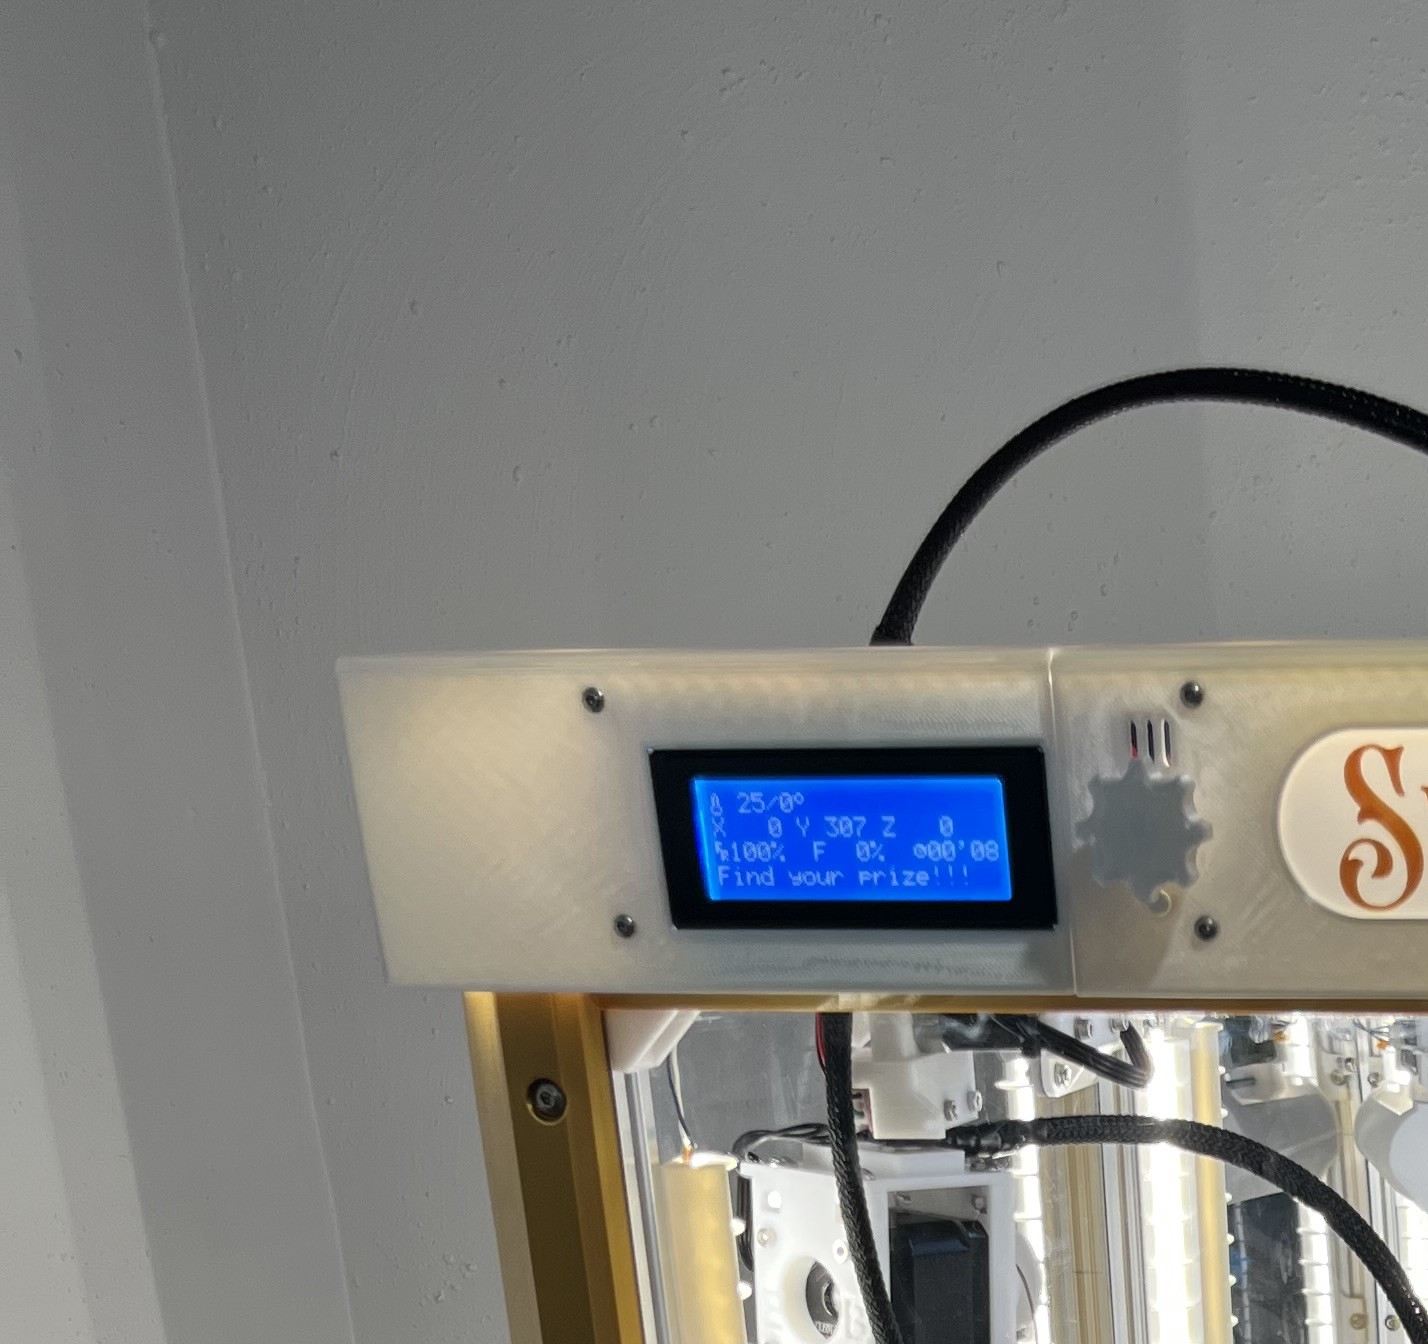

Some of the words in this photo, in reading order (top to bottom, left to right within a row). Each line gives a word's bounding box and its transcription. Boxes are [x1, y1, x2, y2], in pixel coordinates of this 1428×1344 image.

[796, 816, 810, 838] Y
[824, 816, 867, 838] 307
[881, 816, 896, 838] Z
[939, 816, 954, 838] 0
[813, 841, 827, 861] F
[856, 840, 885, 861] 0%
[718, 865, 775, 887] Find
[788, 870, 844, 887] your
